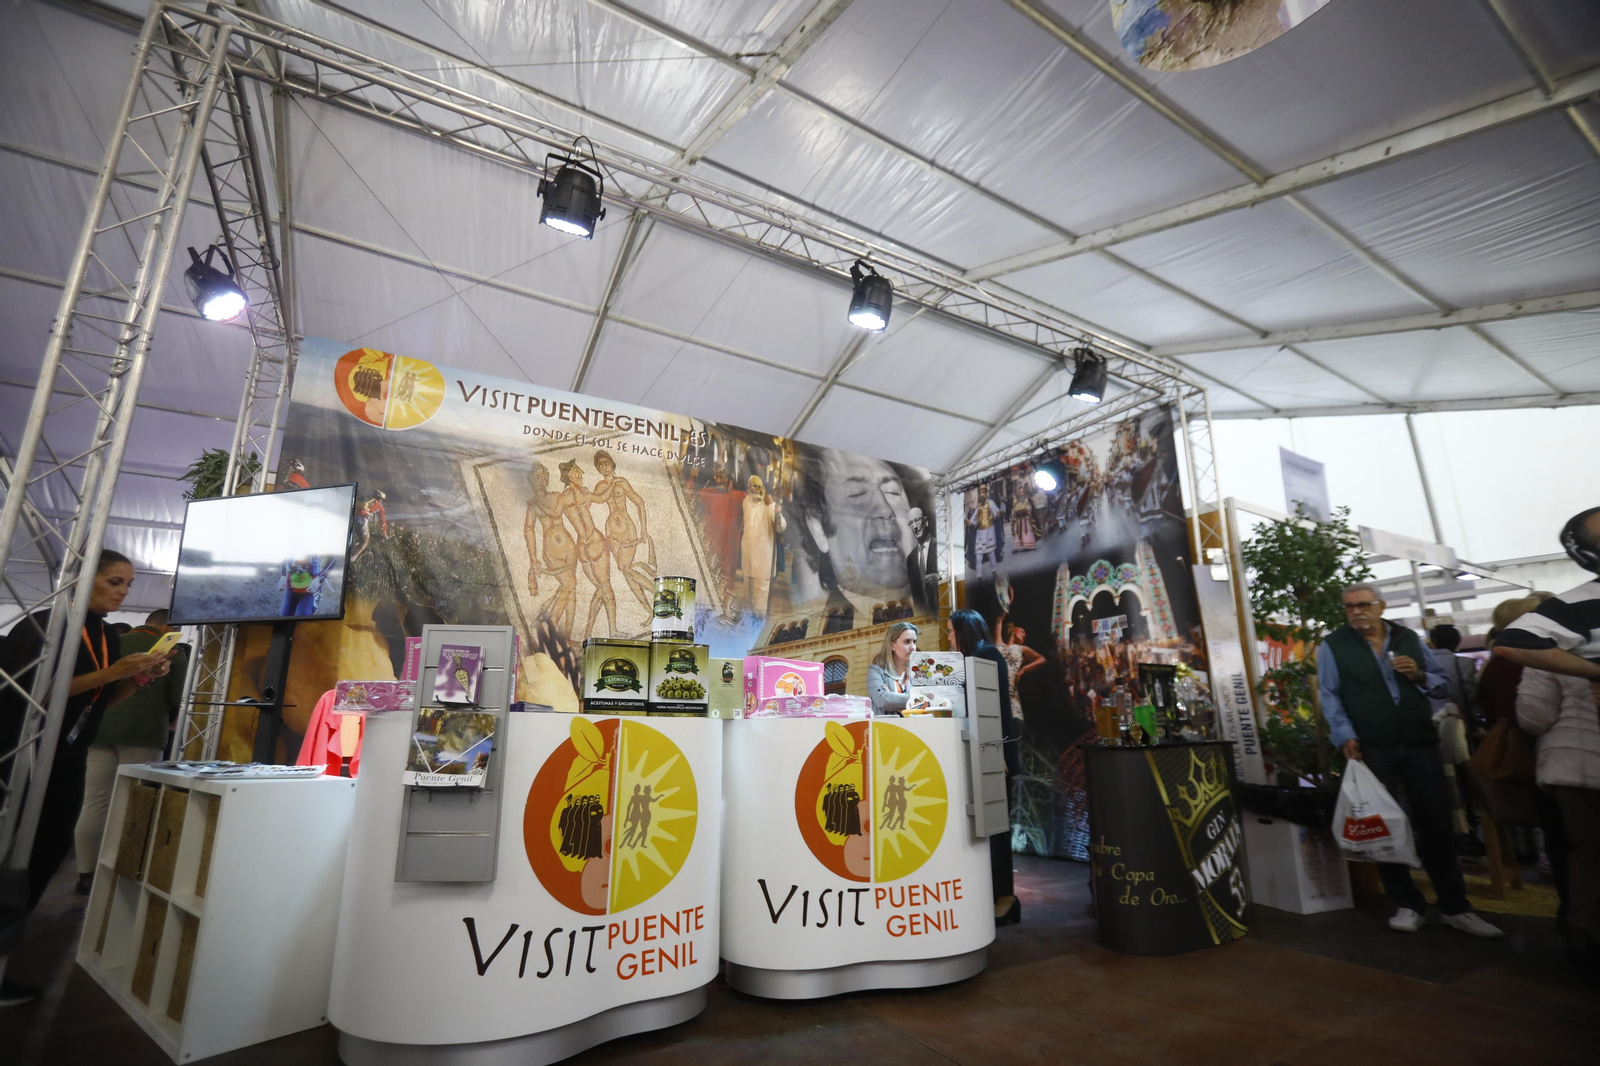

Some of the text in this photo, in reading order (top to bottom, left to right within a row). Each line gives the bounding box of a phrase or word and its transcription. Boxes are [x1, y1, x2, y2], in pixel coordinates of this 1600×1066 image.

[523, 425, 706, 467] DONDE EL SOL SE HACE DULCE
[1219, 667, 1235, 724] MUNICIPIOS
[1231, 671, 1258, 756] PUENTE GENIL
[414, 772, 445, 782] Puente
[1205, 809, 1227, 840] GIN
[1111, 862, 1155, 886] Copa
[757, 878, 964, 928] VISIT PUENTE
[1119, 885, 1140, 906] de
[462, 905, 705, 979] VISIT PUENTE
[886, 908, 960, 938] GENIL
[616, 942, 699, 981] GENIL
